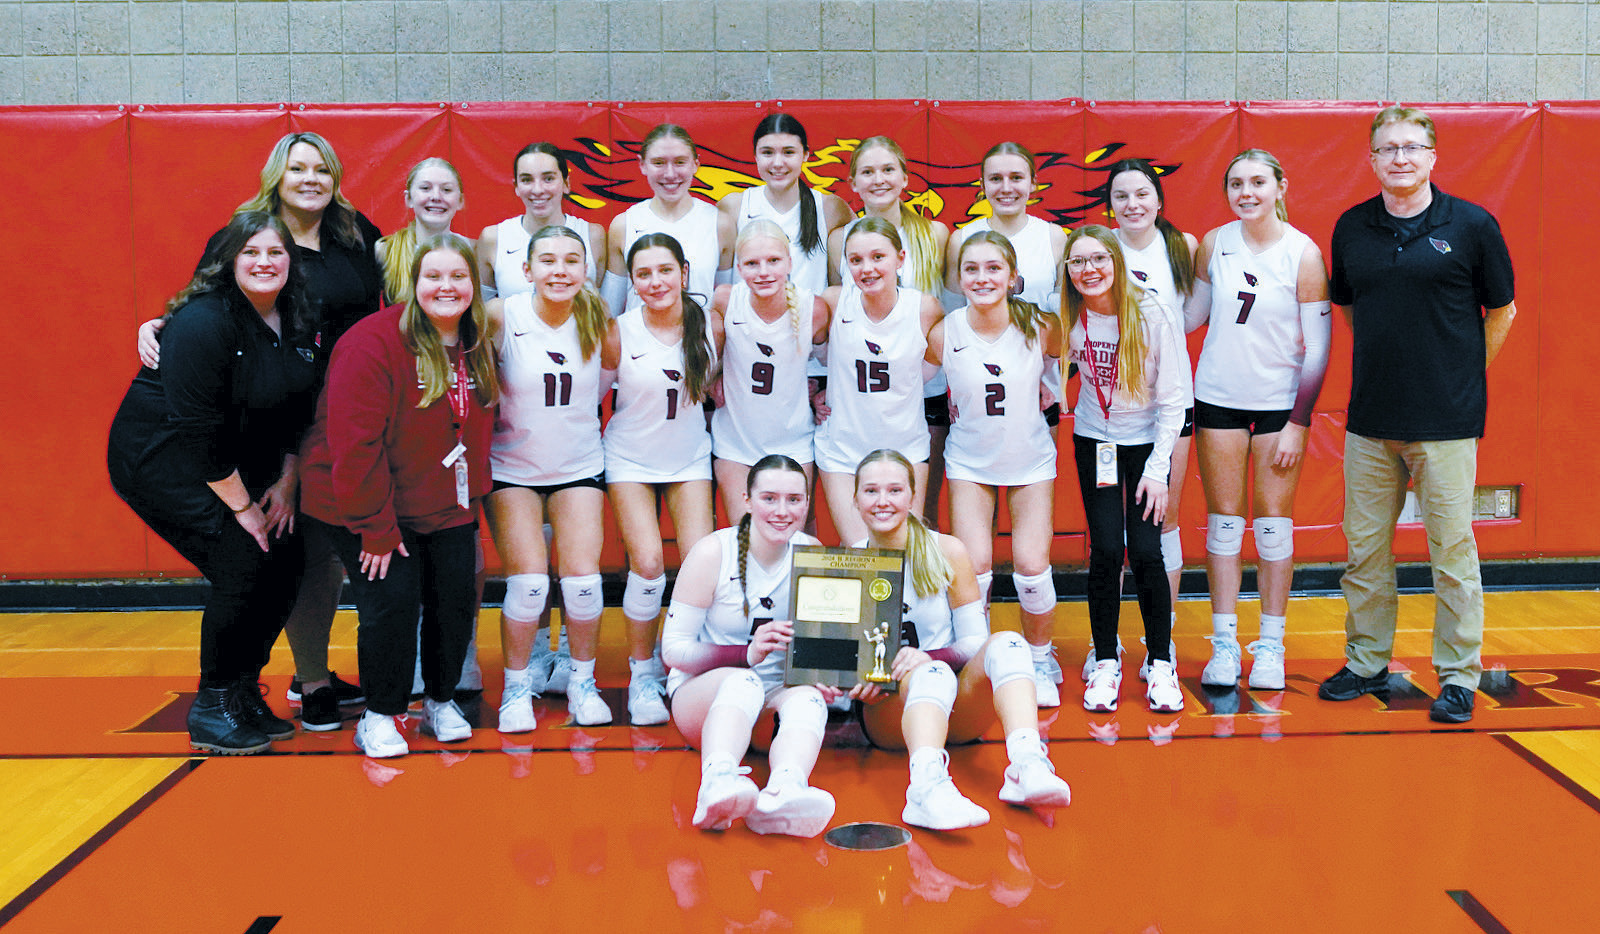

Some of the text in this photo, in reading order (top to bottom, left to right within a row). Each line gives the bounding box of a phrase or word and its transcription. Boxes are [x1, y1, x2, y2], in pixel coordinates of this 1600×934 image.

[1236, 291, 1256, 325] 7
[543, 372, 573, 407] 11
[750, 361, 775, 396] 9
[855, 359, 890, 393] 15
[666, 388, 679, 420] 1
[985, 382, 1006, 416] 2
